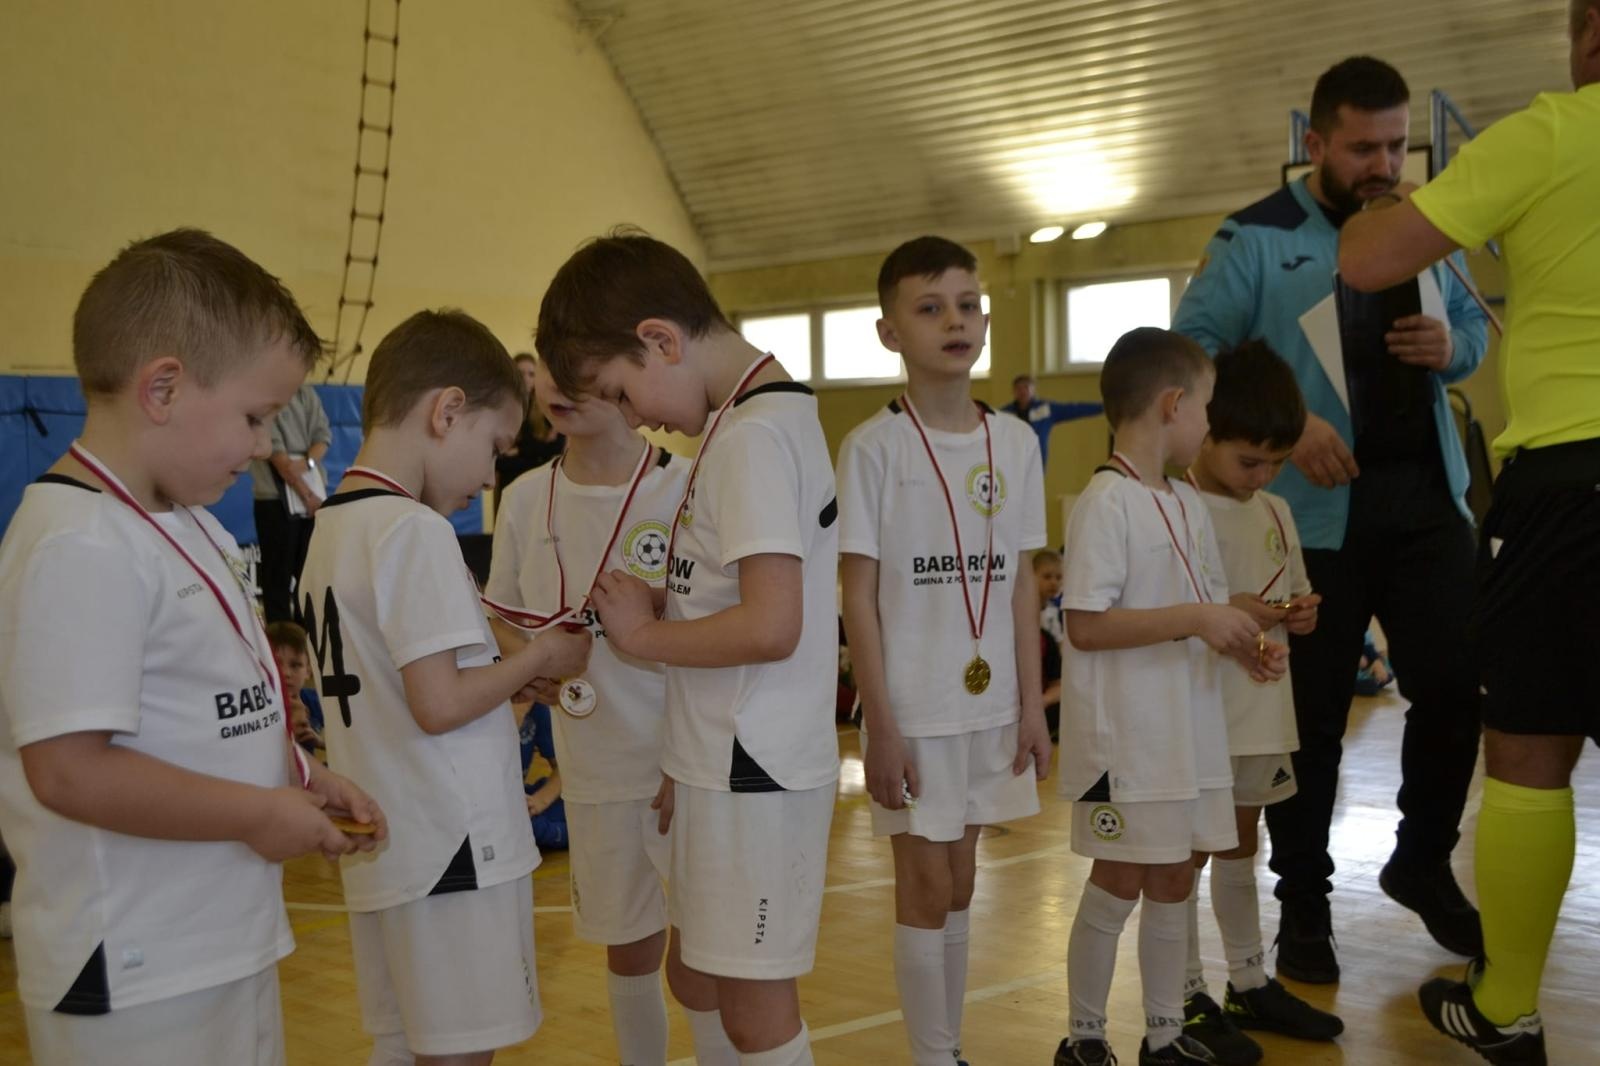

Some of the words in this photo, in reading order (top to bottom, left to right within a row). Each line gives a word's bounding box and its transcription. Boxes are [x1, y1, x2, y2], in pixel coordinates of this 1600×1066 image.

[913, 576, 944, 586] GMINA
[220, 720, 262, 739] GMINA
[754, 897, 769, 945] KIPSTA
